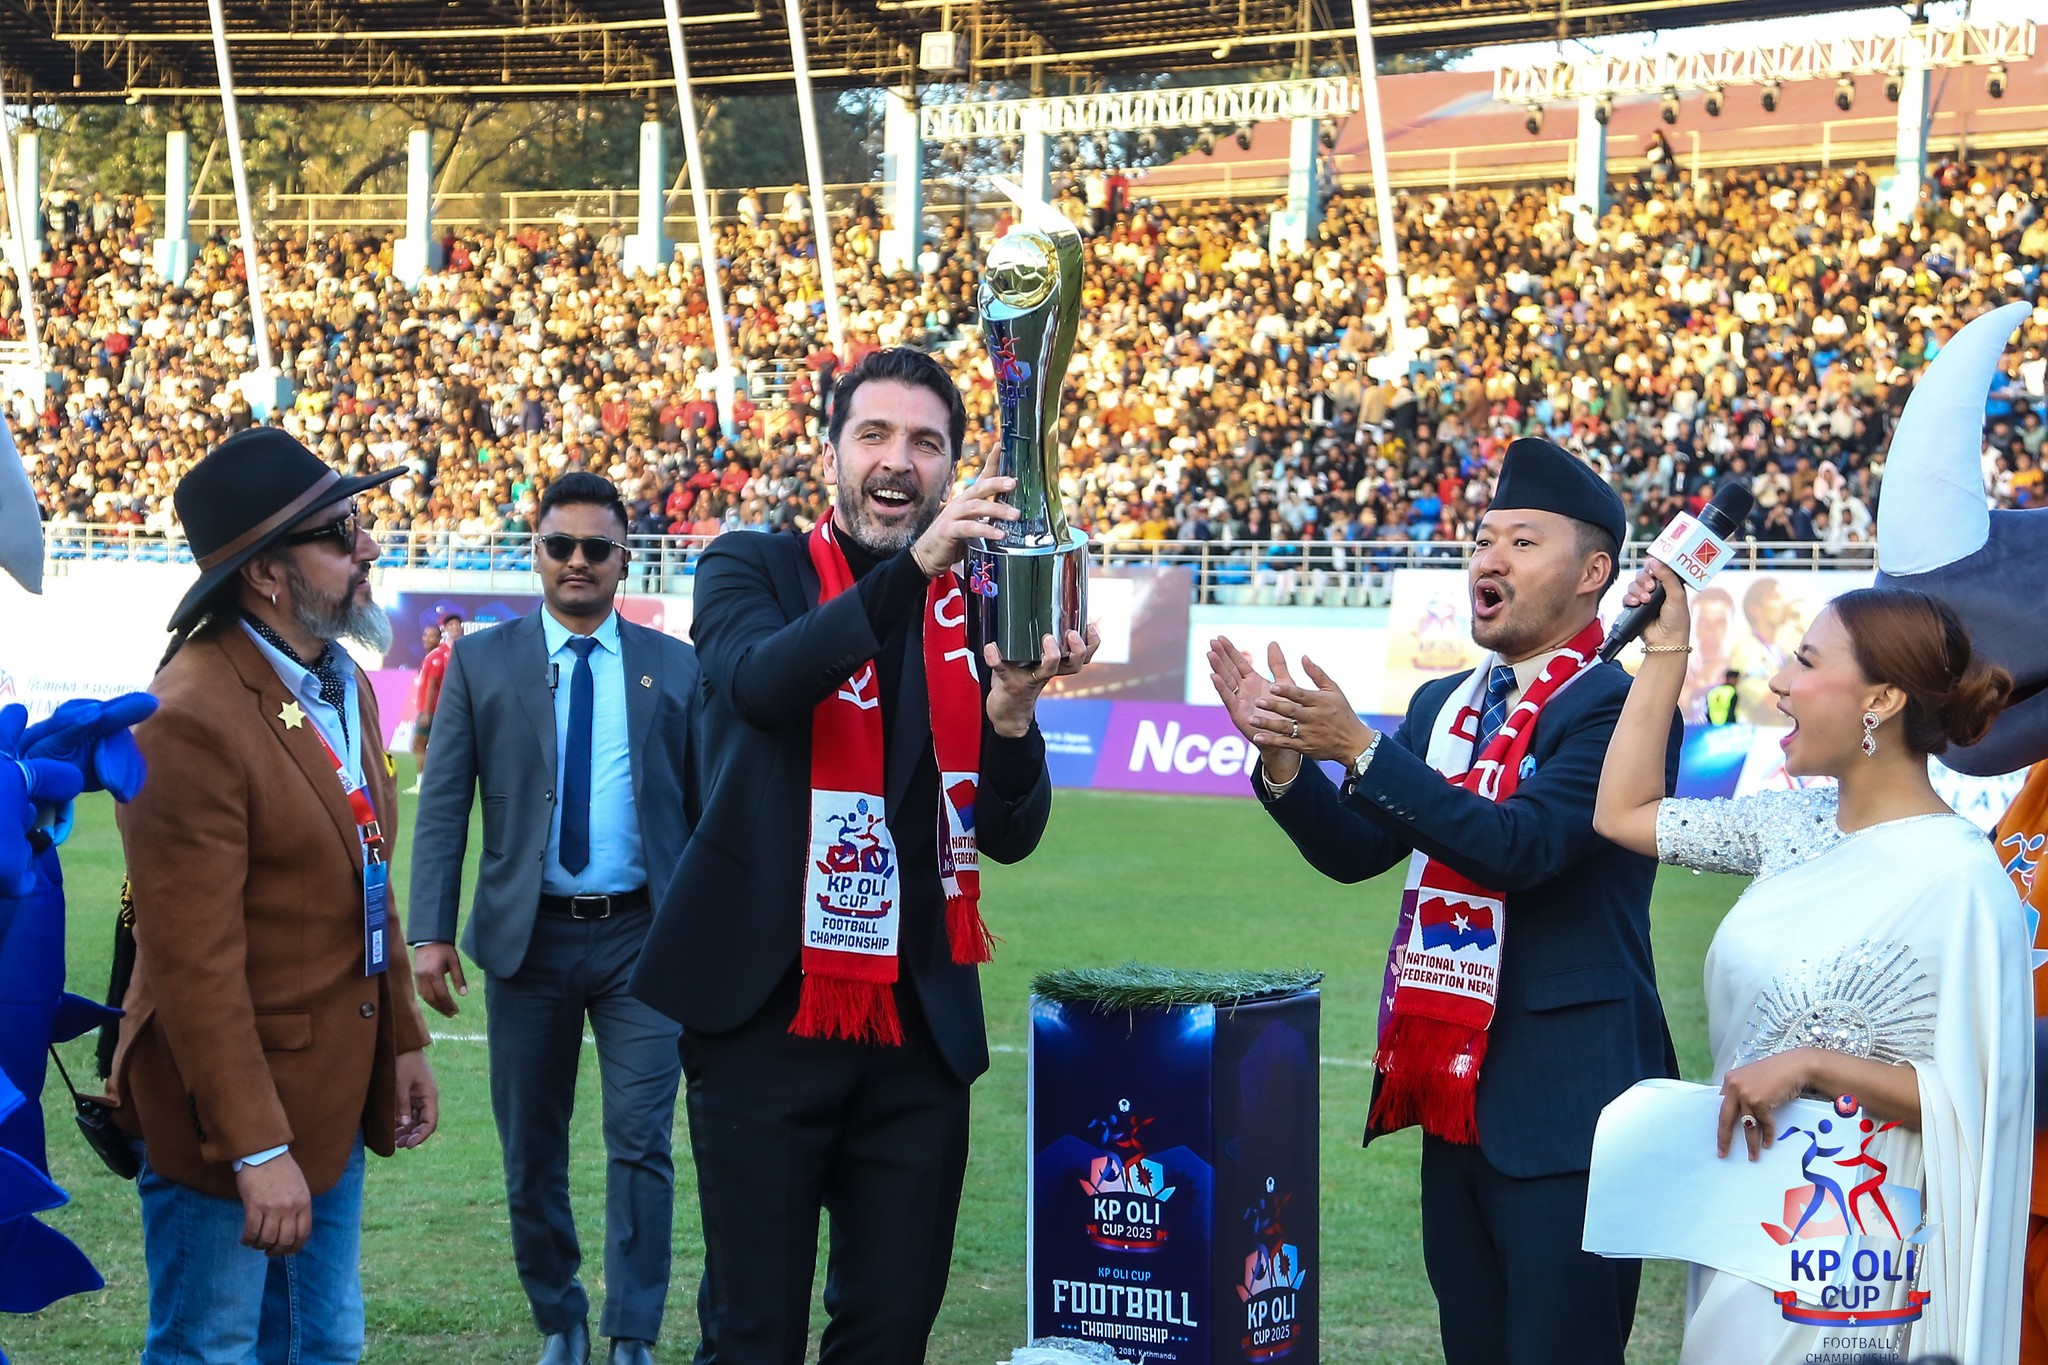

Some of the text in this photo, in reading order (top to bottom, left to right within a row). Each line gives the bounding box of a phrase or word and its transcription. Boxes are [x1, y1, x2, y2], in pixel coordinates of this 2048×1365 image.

[1676, 553, 1708, 582] max
[827, 876, 886, 896] KP OLI
[839, 894, 868, 908] CUP
[822, 917, 878, 934] FOOTBALL
[810, 930, 889, 950] CHAMPIONSHIP
[1406, 952, 1494, 980] NATIONAL YOUTH
[1403, 968, 1494, 997] FEDERATION NEPAL
[1094, 1198, 1160, 1225] KP OLI
[1102, 1223, 1152, 1239] CUP 2025
[1098, 1267, 1151, 1282] KP OLI CUP
[1052, 1279, 1198, 1328] FOOTBALL
[1247, 1293, 1296, 1330] KP OLI
[1081, 1320, 1168, 1344] CHAMPIONSHIP
[1253, 1324, 1290, 1346] CUP 2025
